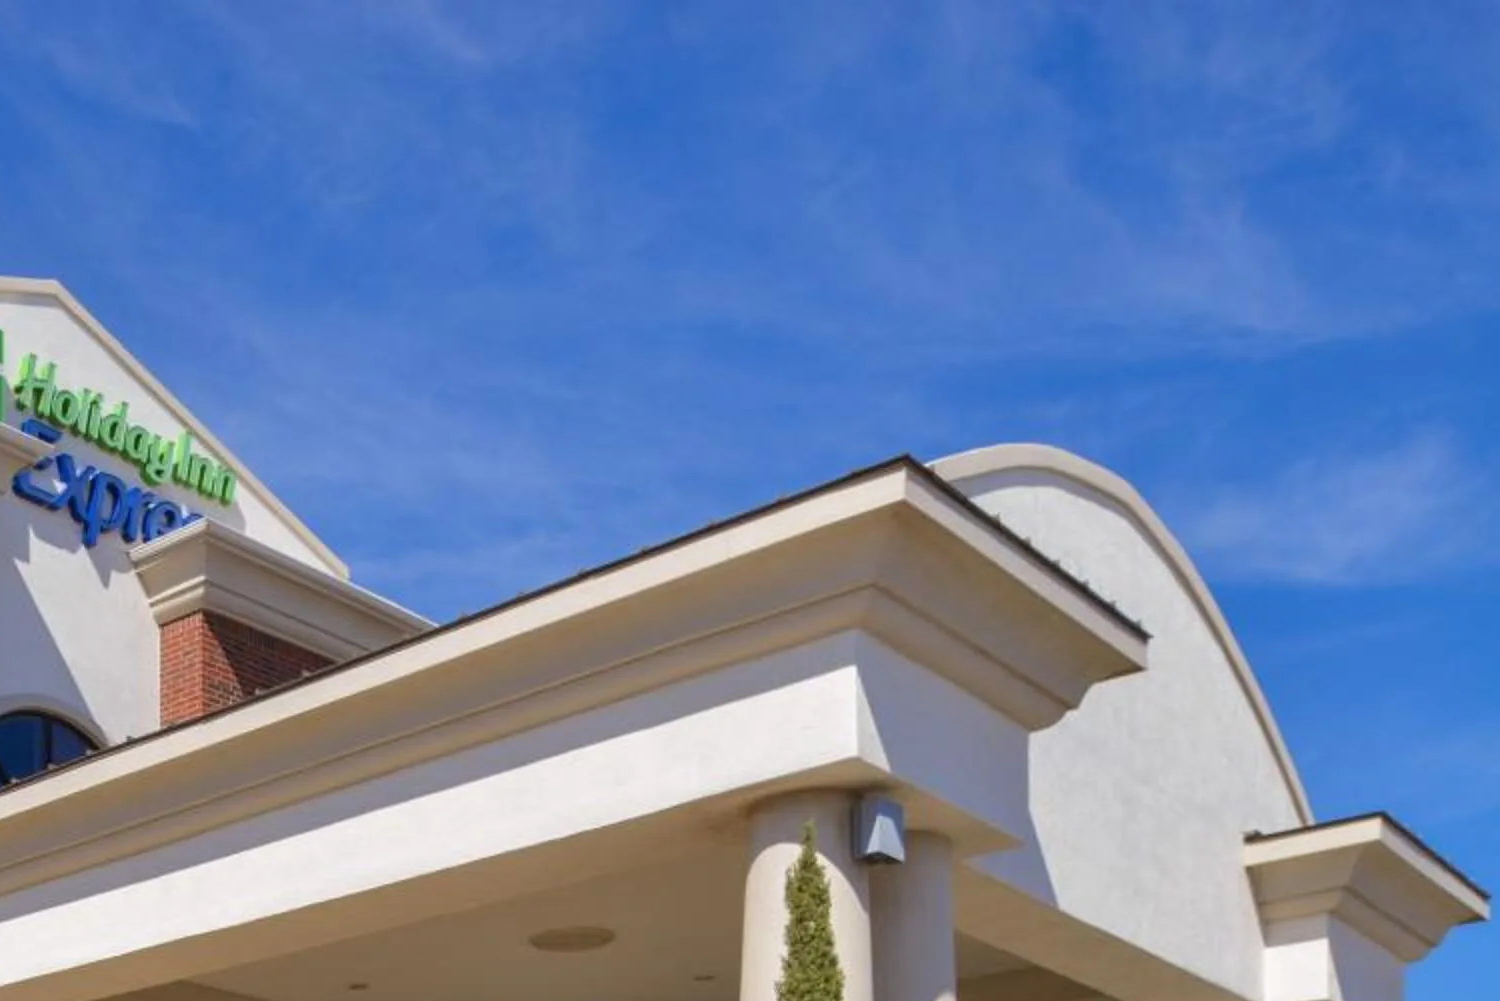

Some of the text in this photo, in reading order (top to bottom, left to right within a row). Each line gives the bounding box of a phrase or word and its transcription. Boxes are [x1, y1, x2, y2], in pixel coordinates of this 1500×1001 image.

[12, 419, 204, 549] Expre
[14, 353, 237, 505] Holiday Inn
